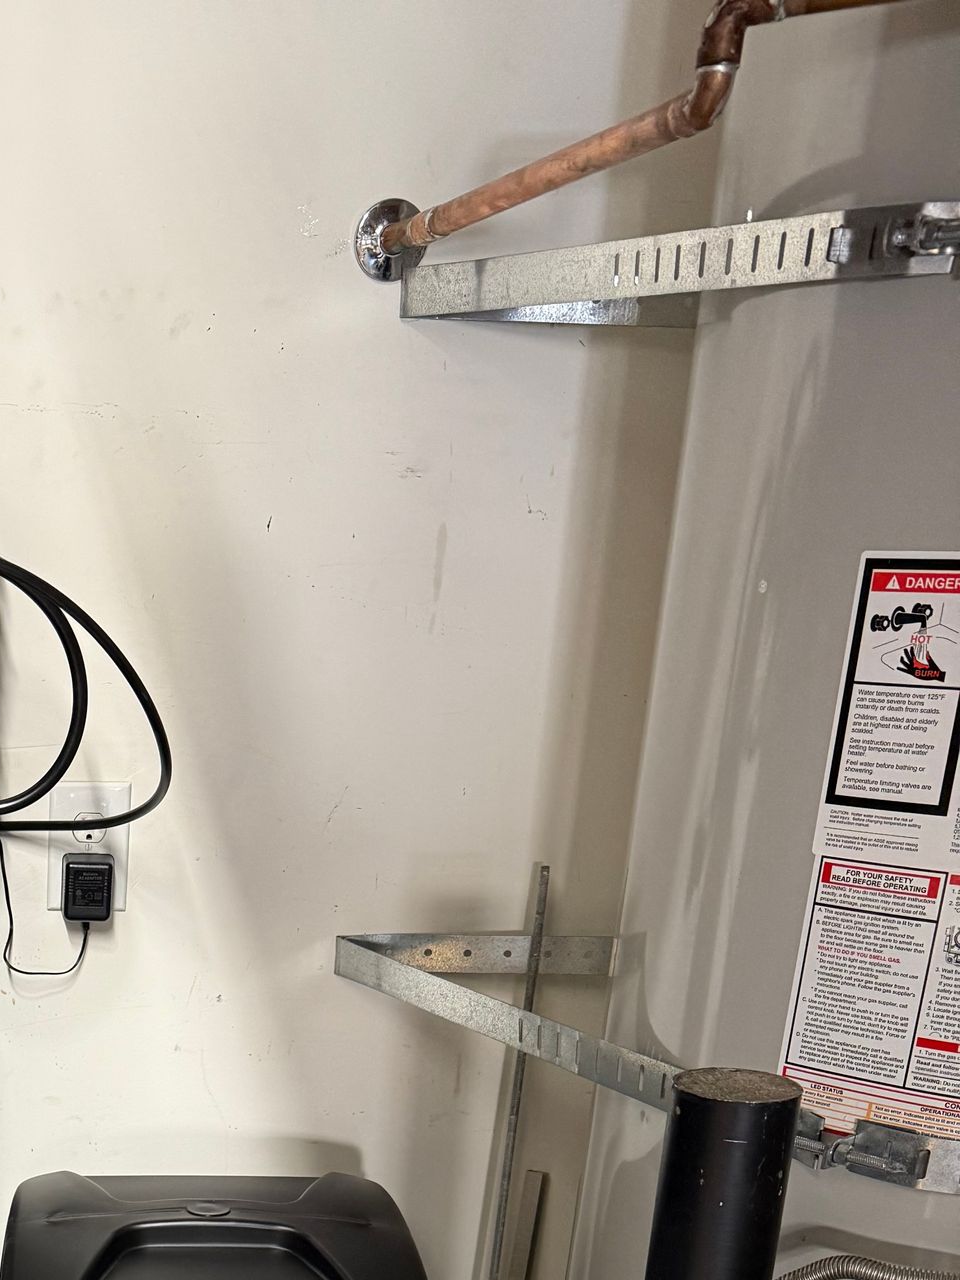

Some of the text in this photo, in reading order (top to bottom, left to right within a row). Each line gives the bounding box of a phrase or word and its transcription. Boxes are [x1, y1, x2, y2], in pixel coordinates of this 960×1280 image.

[910, 634, 932, 644] HOT
[914, 670, 940, 678] BURN
[876, 690, 911, 699] temperature
[855, 702, 878, 711] instantly
[854, 713, 878, 722] Children,
[918, 717, 939, 726] elderly
[869, 721, 891, 729] highest
[910, 724, 928, 733] being
[862, 738, 891, 746] instruction
[848, 744, 867, 752] setting
[868, 745, 903, 754] temperature
[895, 763, 918, 772] bathing
[844, 775, 879, 785] Temperature
[879, 779, 900, 789] limiting
[842, 783, 868, 793] available,
[846, 869, 914, 885] FOR YOUR SAFETY
[831, 874, 927, 894] READ BEFORE OPERATING
[822, 1086, 843, 1095] STATUS
